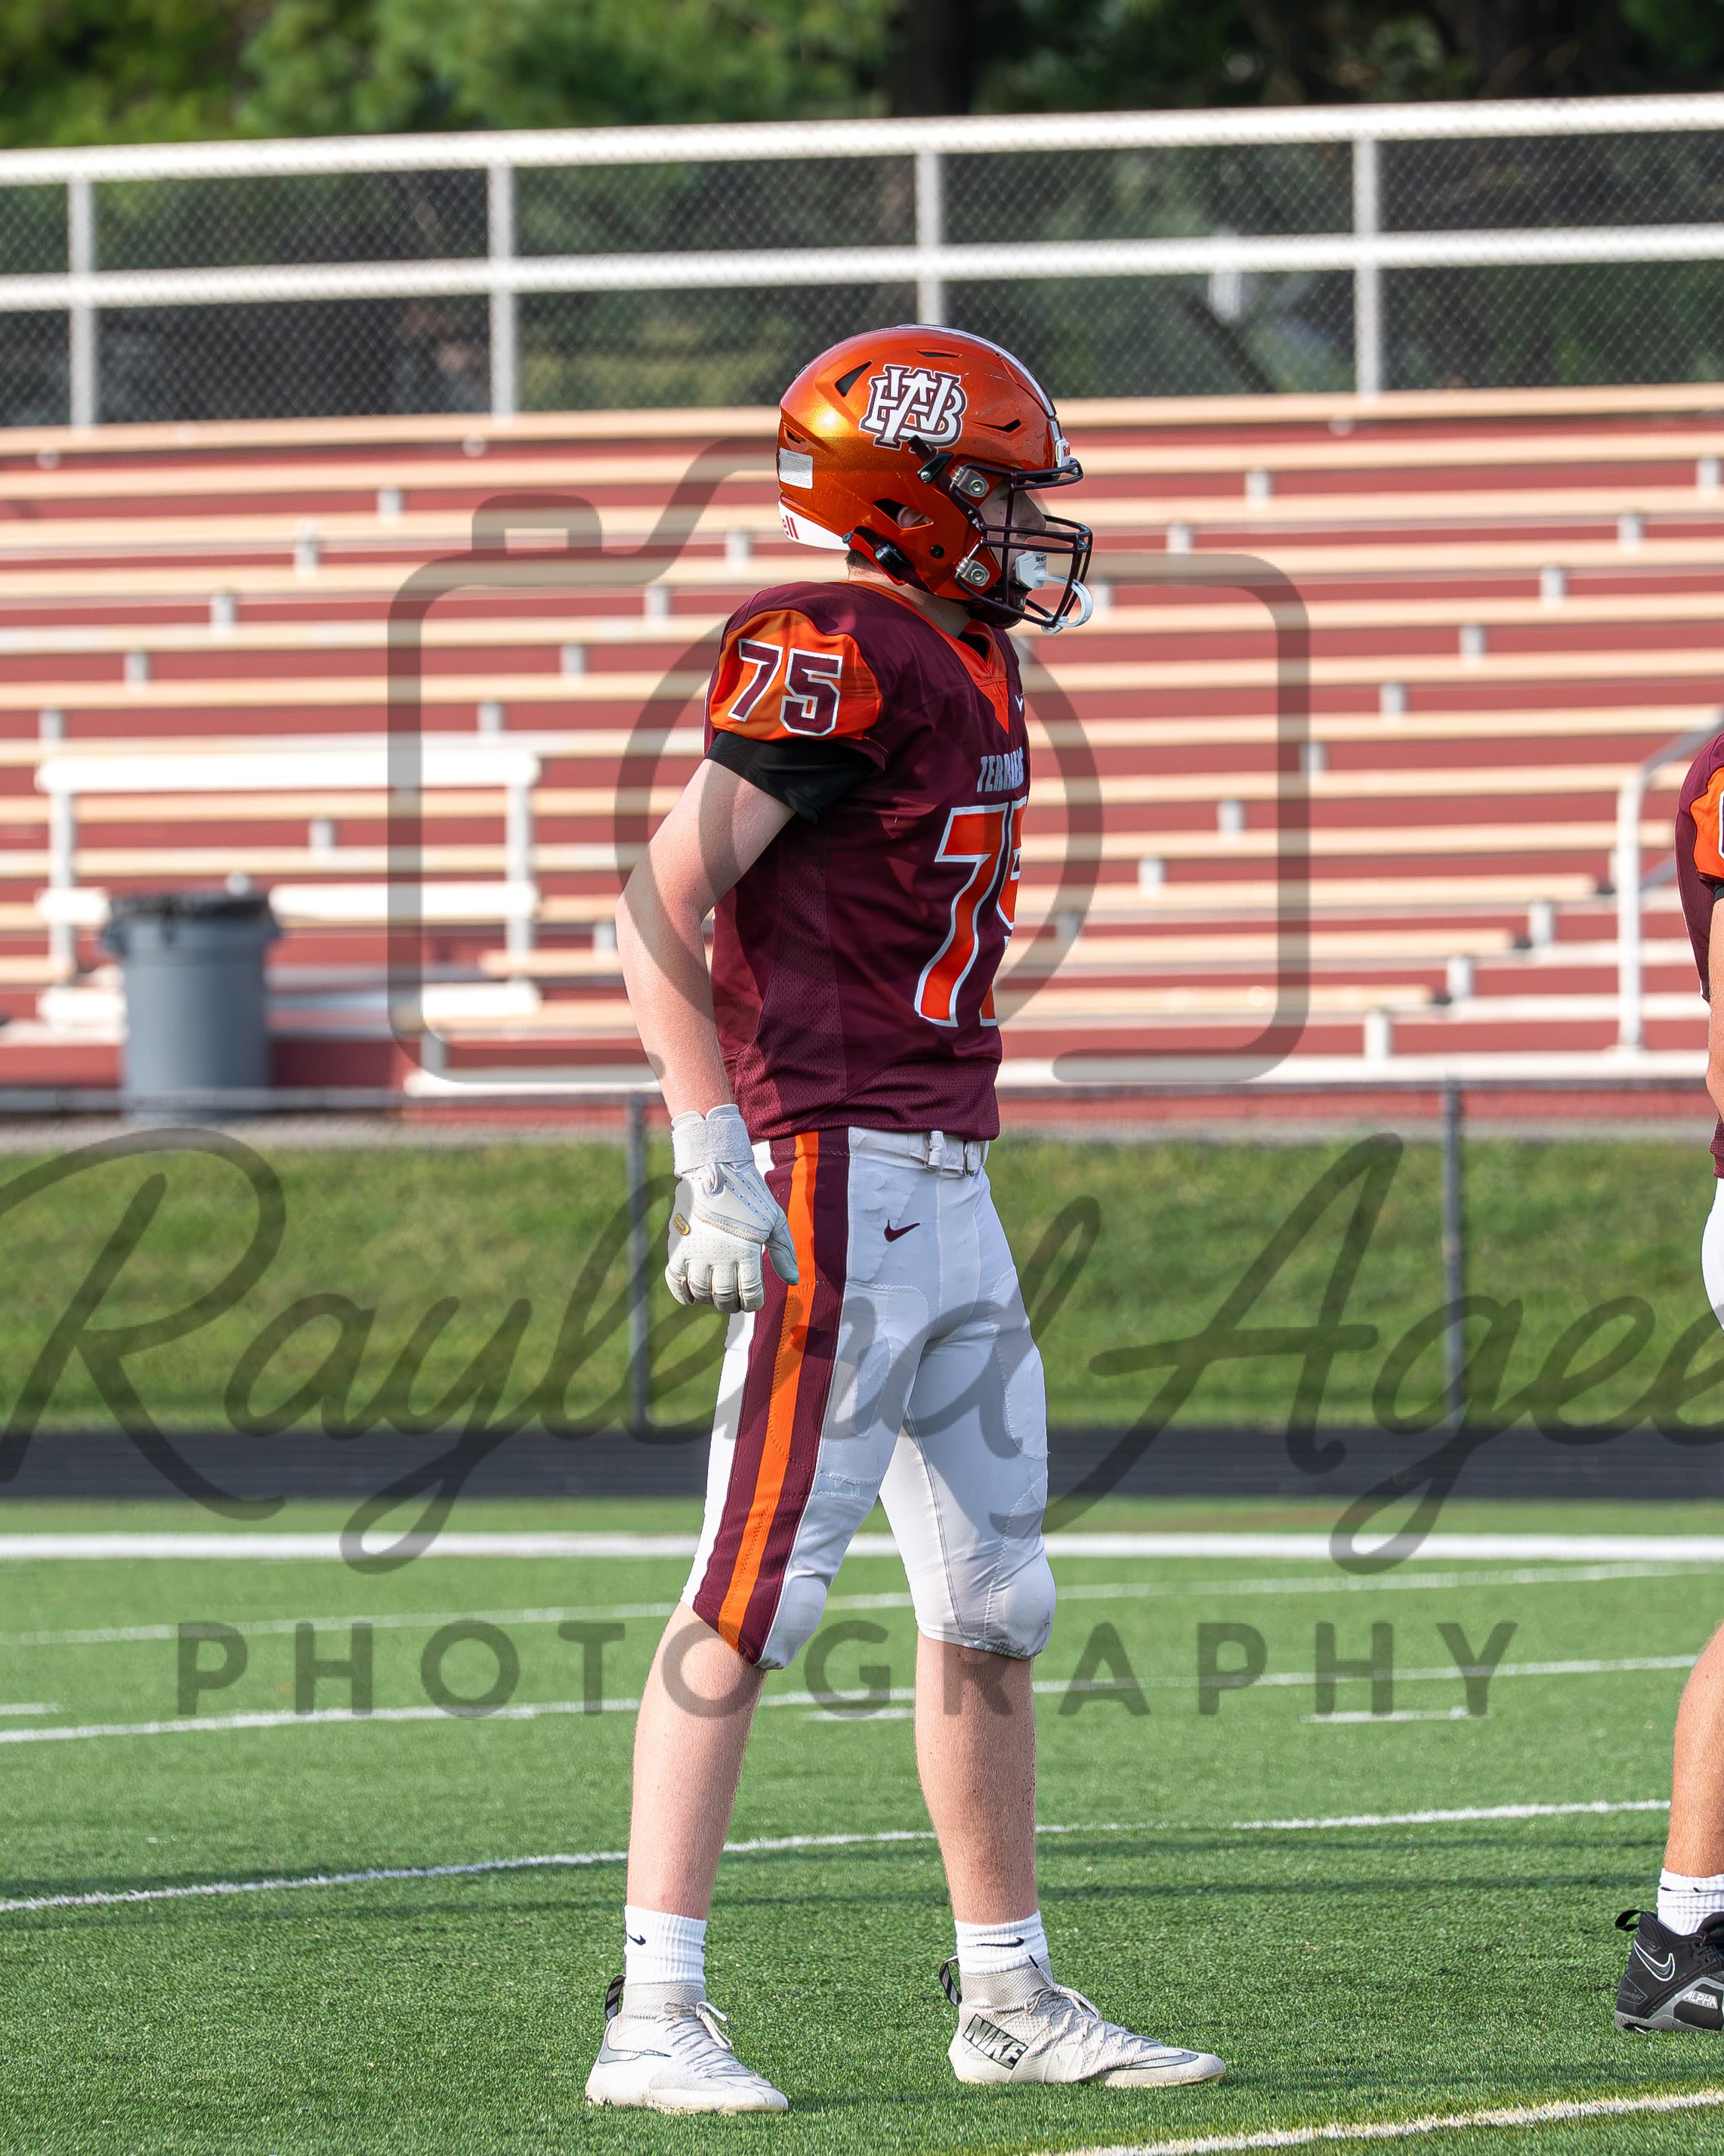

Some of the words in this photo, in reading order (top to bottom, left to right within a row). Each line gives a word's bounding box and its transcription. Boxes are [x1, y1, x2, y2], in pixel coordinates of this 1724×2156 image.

[727, 639, 844, 737] 75
[1682, 1991, 1718, 2009] ALPHA
[962, 2013, 1028, 2071] NIKE
